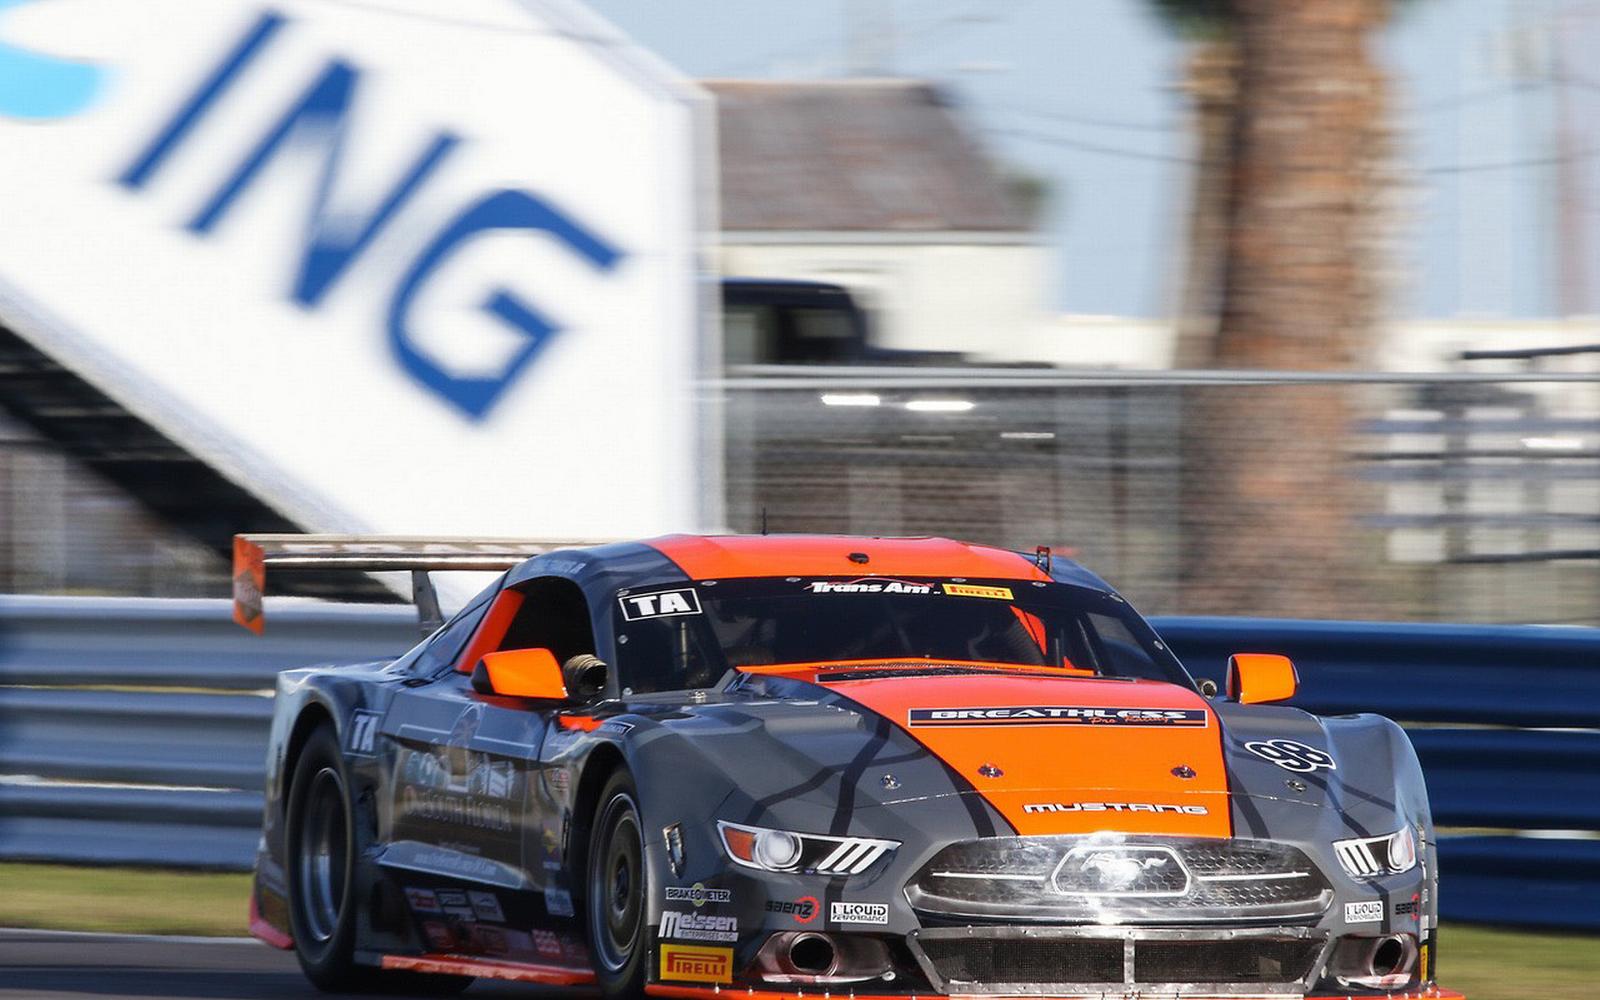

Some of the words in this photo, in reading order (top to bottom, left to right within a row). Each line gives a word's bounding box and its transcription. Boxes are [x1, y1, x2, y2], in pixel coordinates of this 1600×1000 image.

[115, 9, 625, 421] ING
[811, 581, 882, 593] Trans
[884, 581, 930, 594] Am
[950, 585, 1006, 597] PIRELLI
[629, 592, 692, 616] TA
[930, 707, 1186, 719] BREATHLESS
[351, 714, 379, 752] TA
[1023, 802, 1209, 815] MUSTANG
[658, 911, 738, 938] Meissen
[667, 952, 727, 976] PIRELLI
